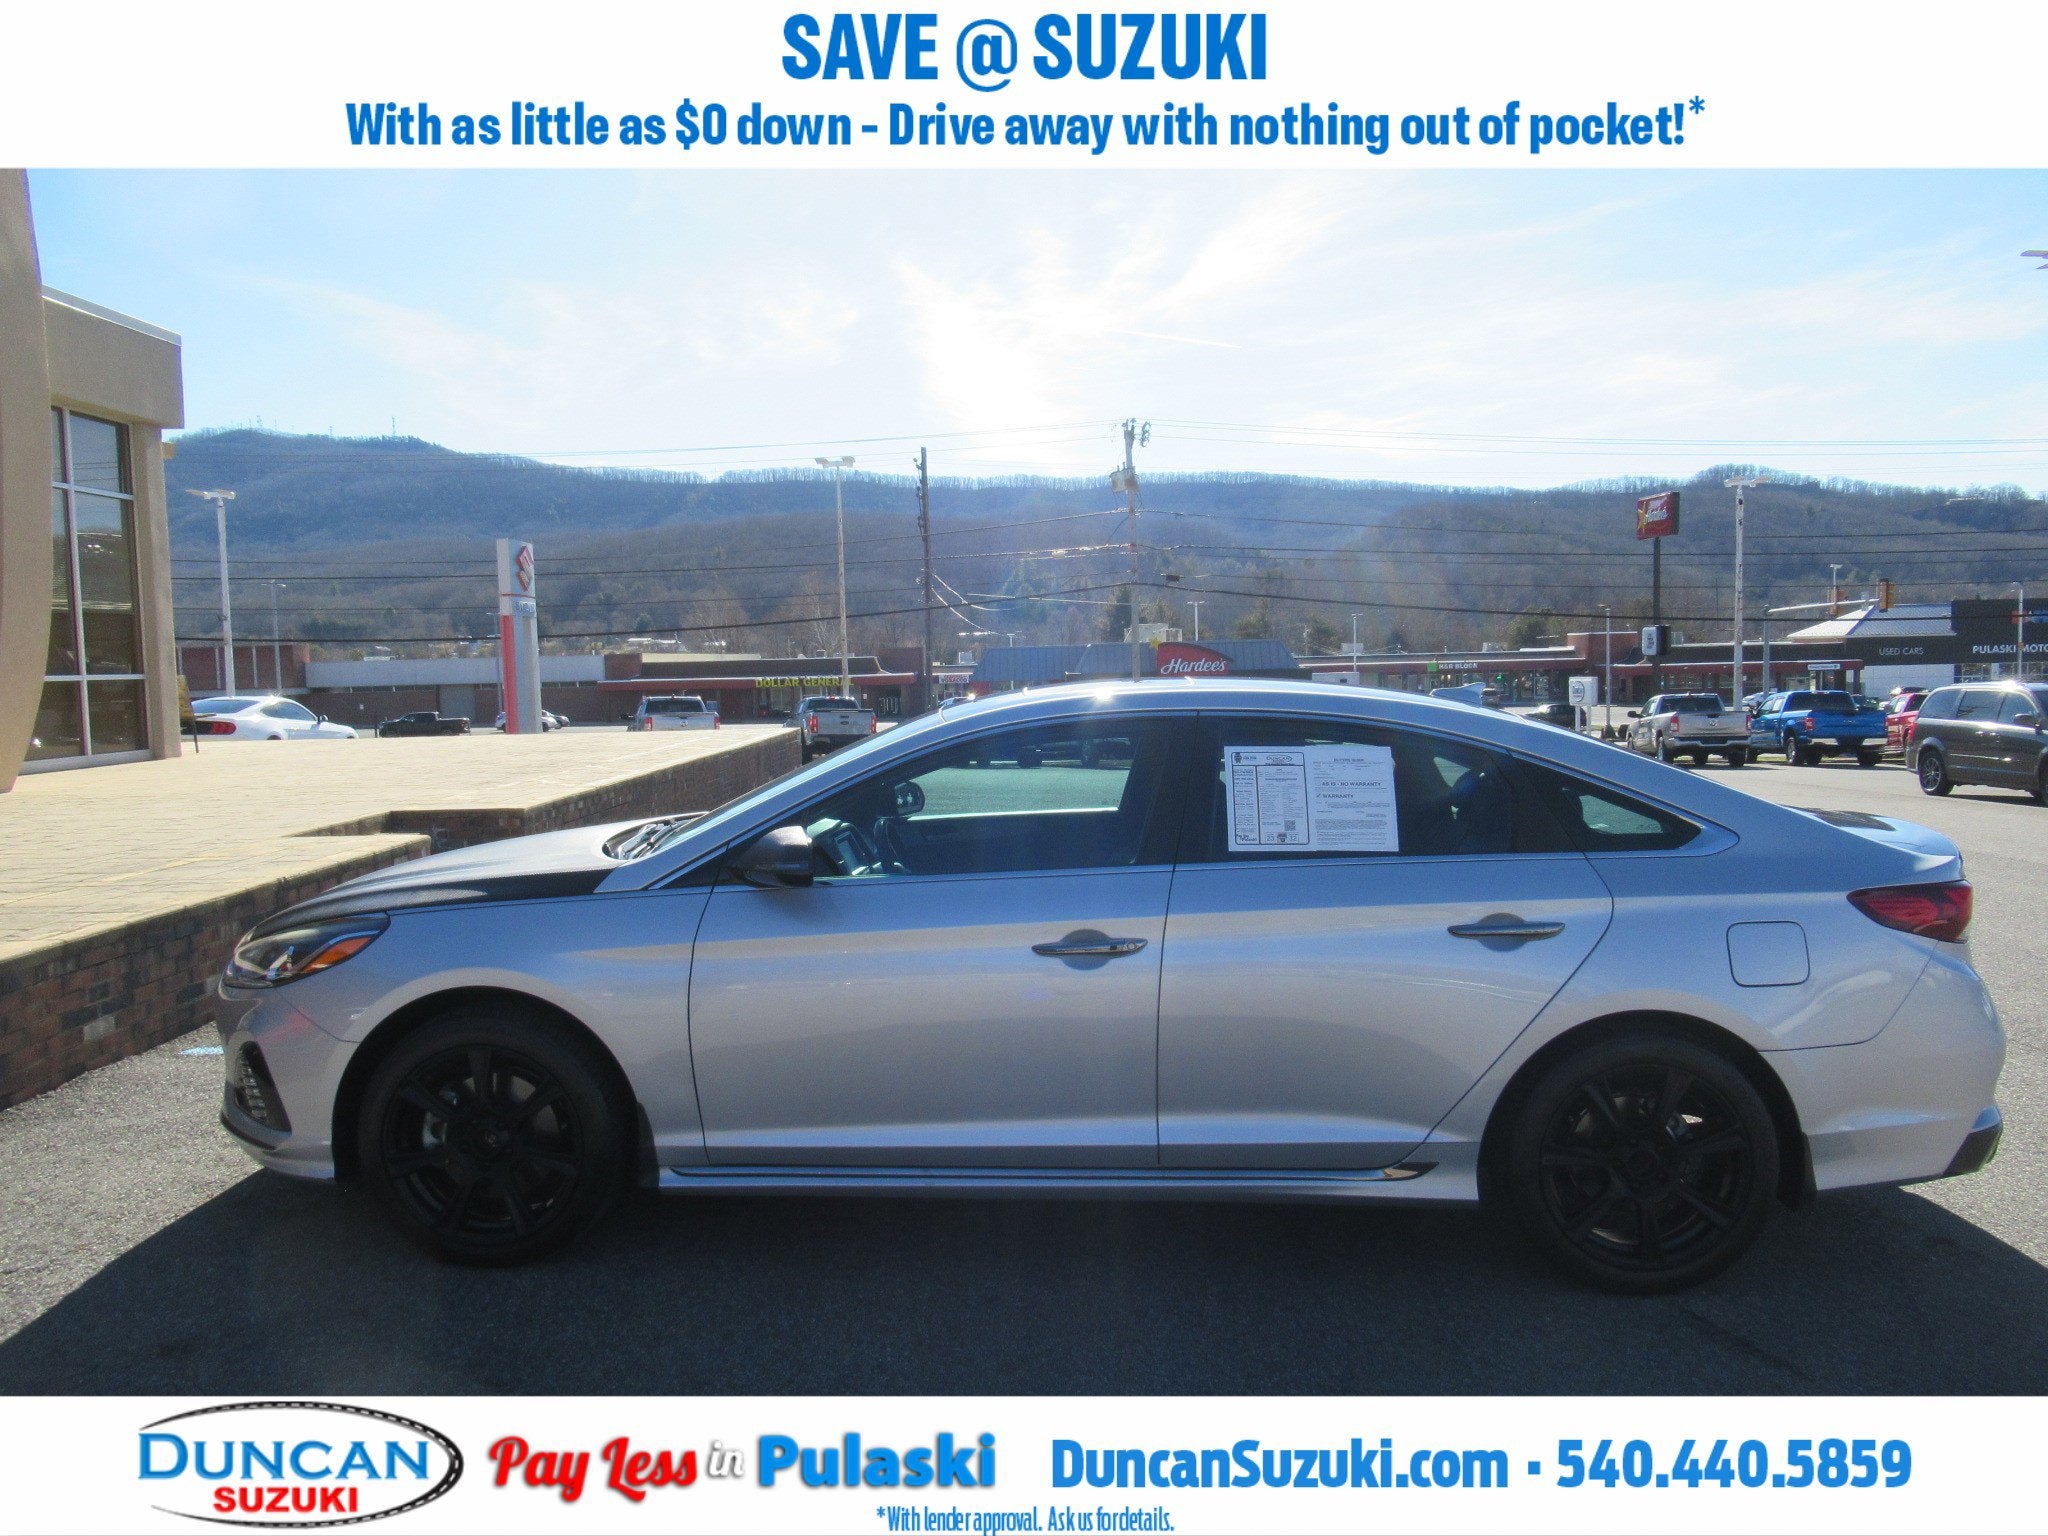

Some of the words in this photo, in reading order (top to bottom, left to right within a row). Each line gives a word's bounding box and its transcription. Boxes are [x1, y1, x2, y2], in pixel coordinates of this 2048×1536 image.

[1879, 647, 1900, 655] USED
[1903, 647, 1924, 655] CARS
[1973, 644, 2016, 653] PULASKI
[1160, 658, 1226, 674] Hardee's
[756, 677, 800, 688] DOLLAR
